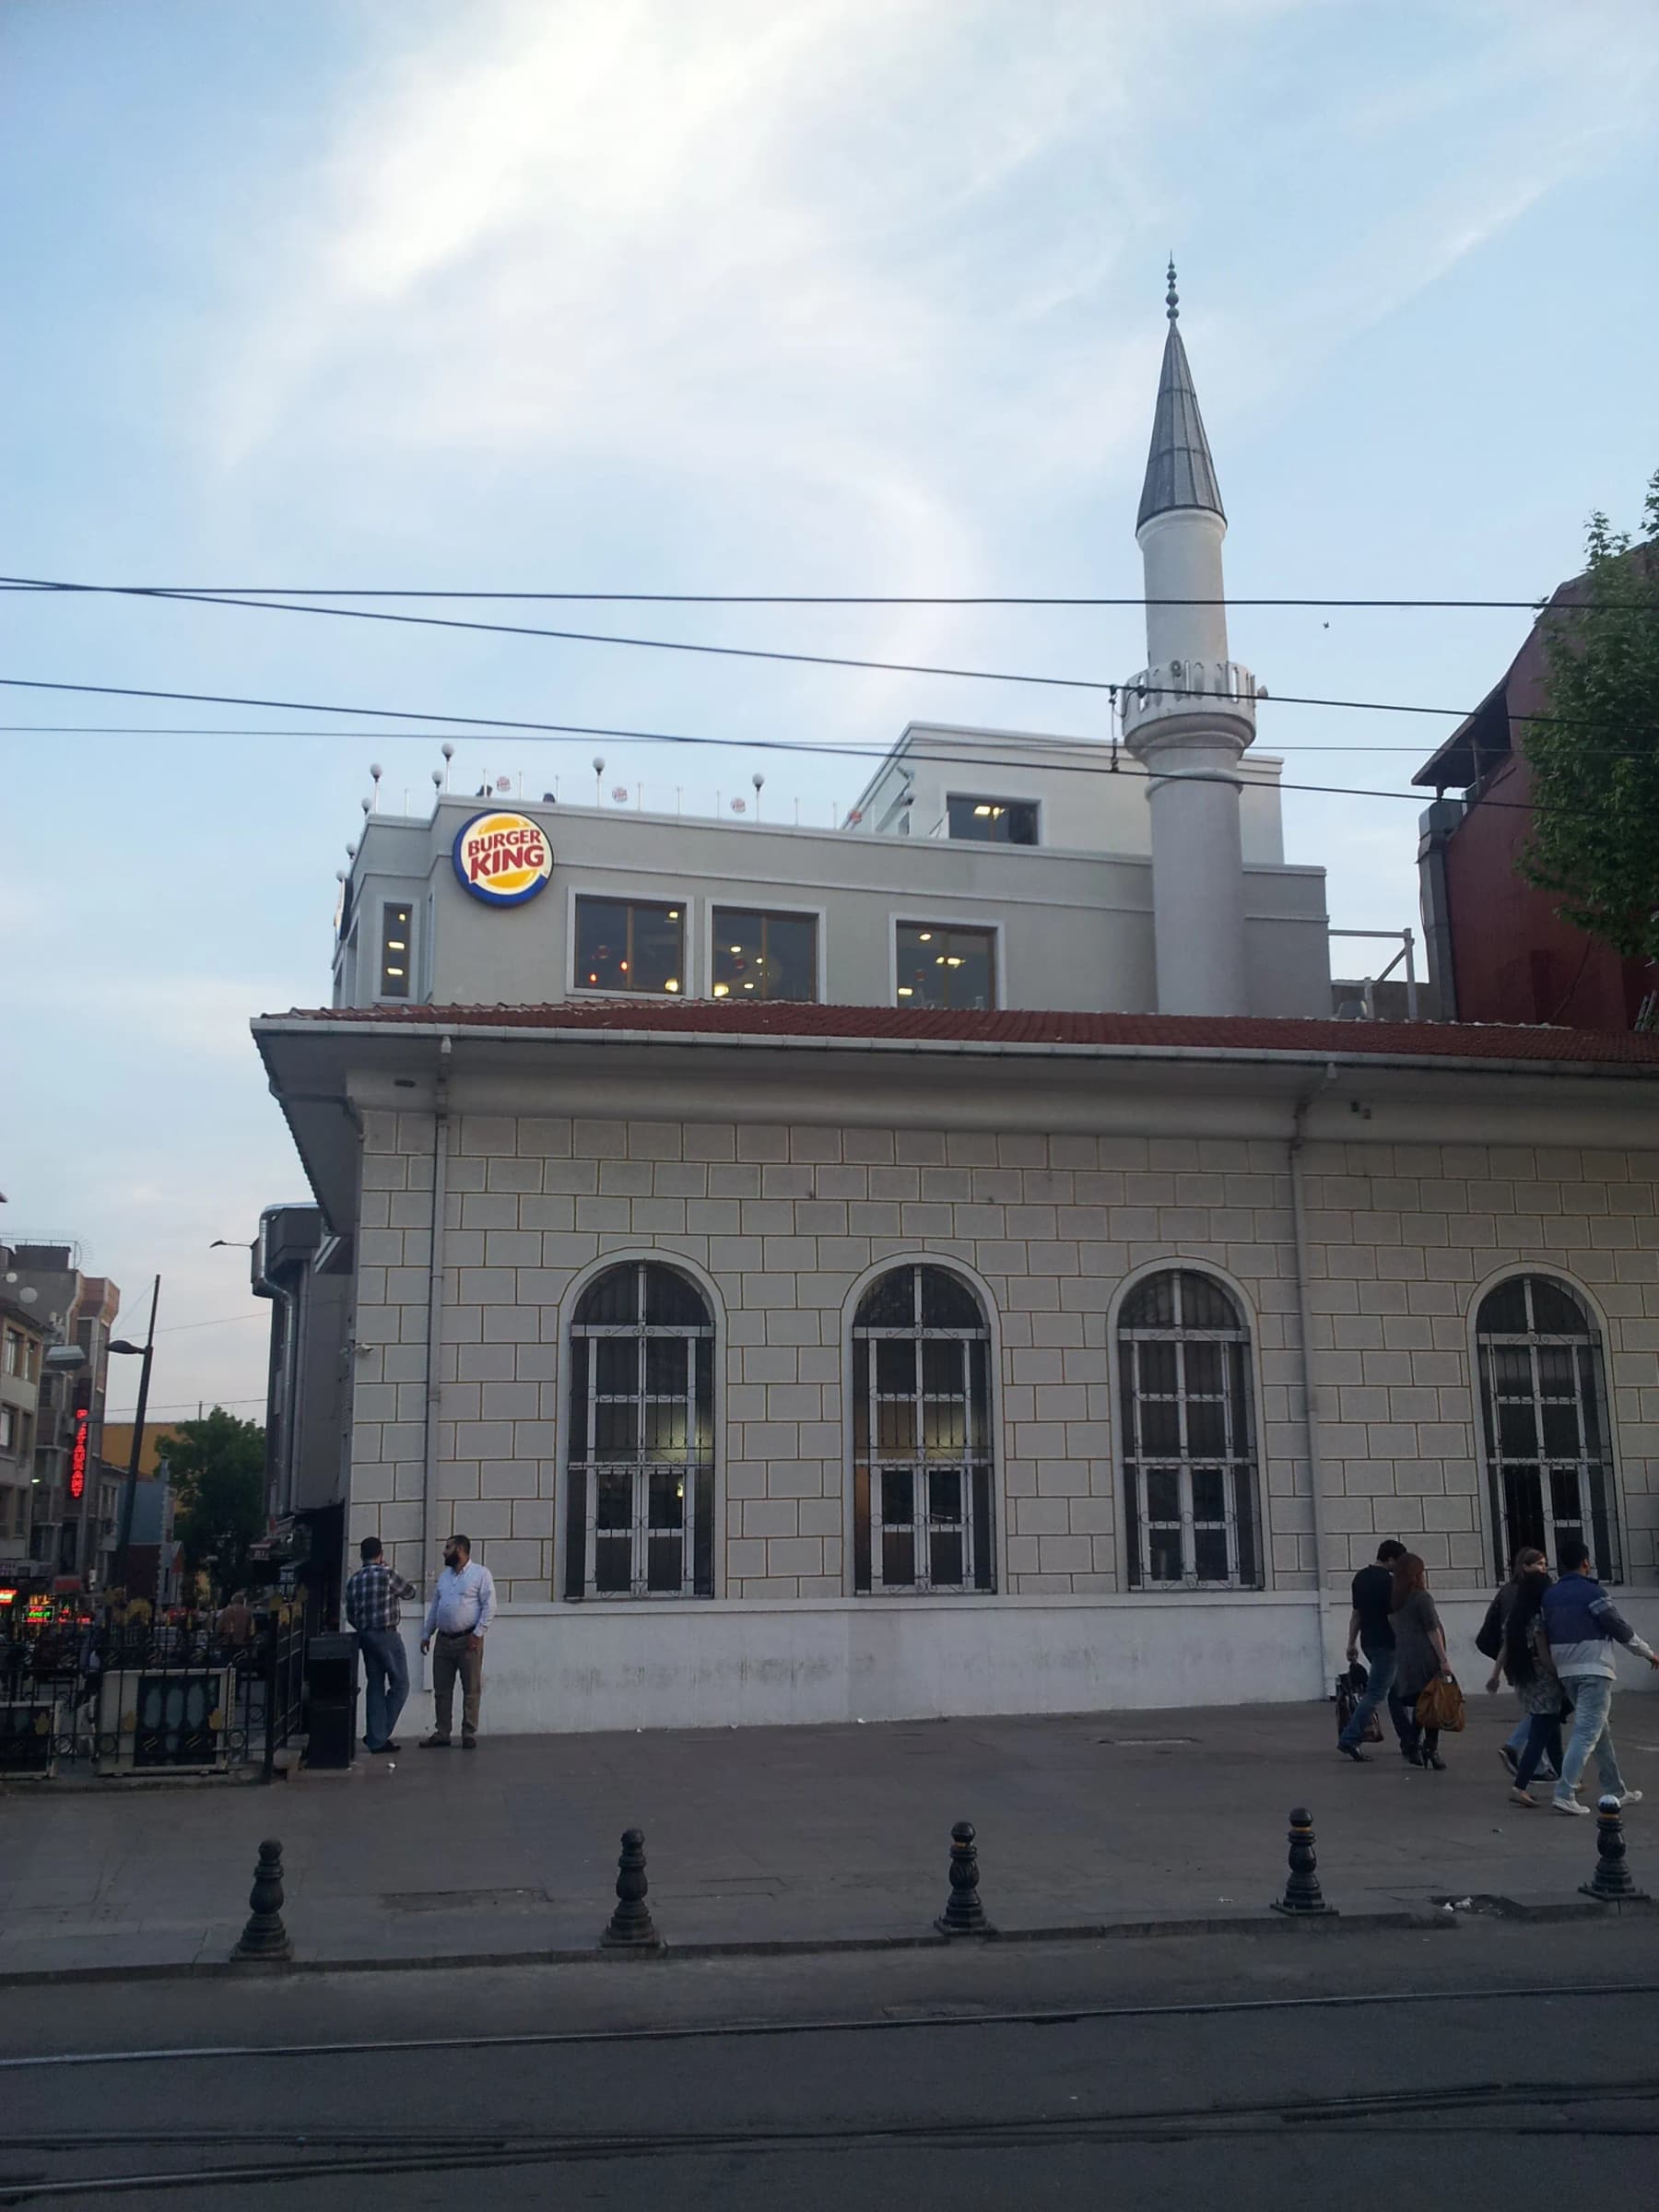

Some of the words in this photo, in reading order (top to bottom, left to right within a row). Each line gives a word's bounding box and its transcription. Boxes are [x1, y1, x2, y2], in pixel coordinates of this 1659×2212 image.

[468, 830, 542, 858] BURGER
[470, 845, 545, 881] KING
[71, 1408, 88, 1498] RTAURANT
